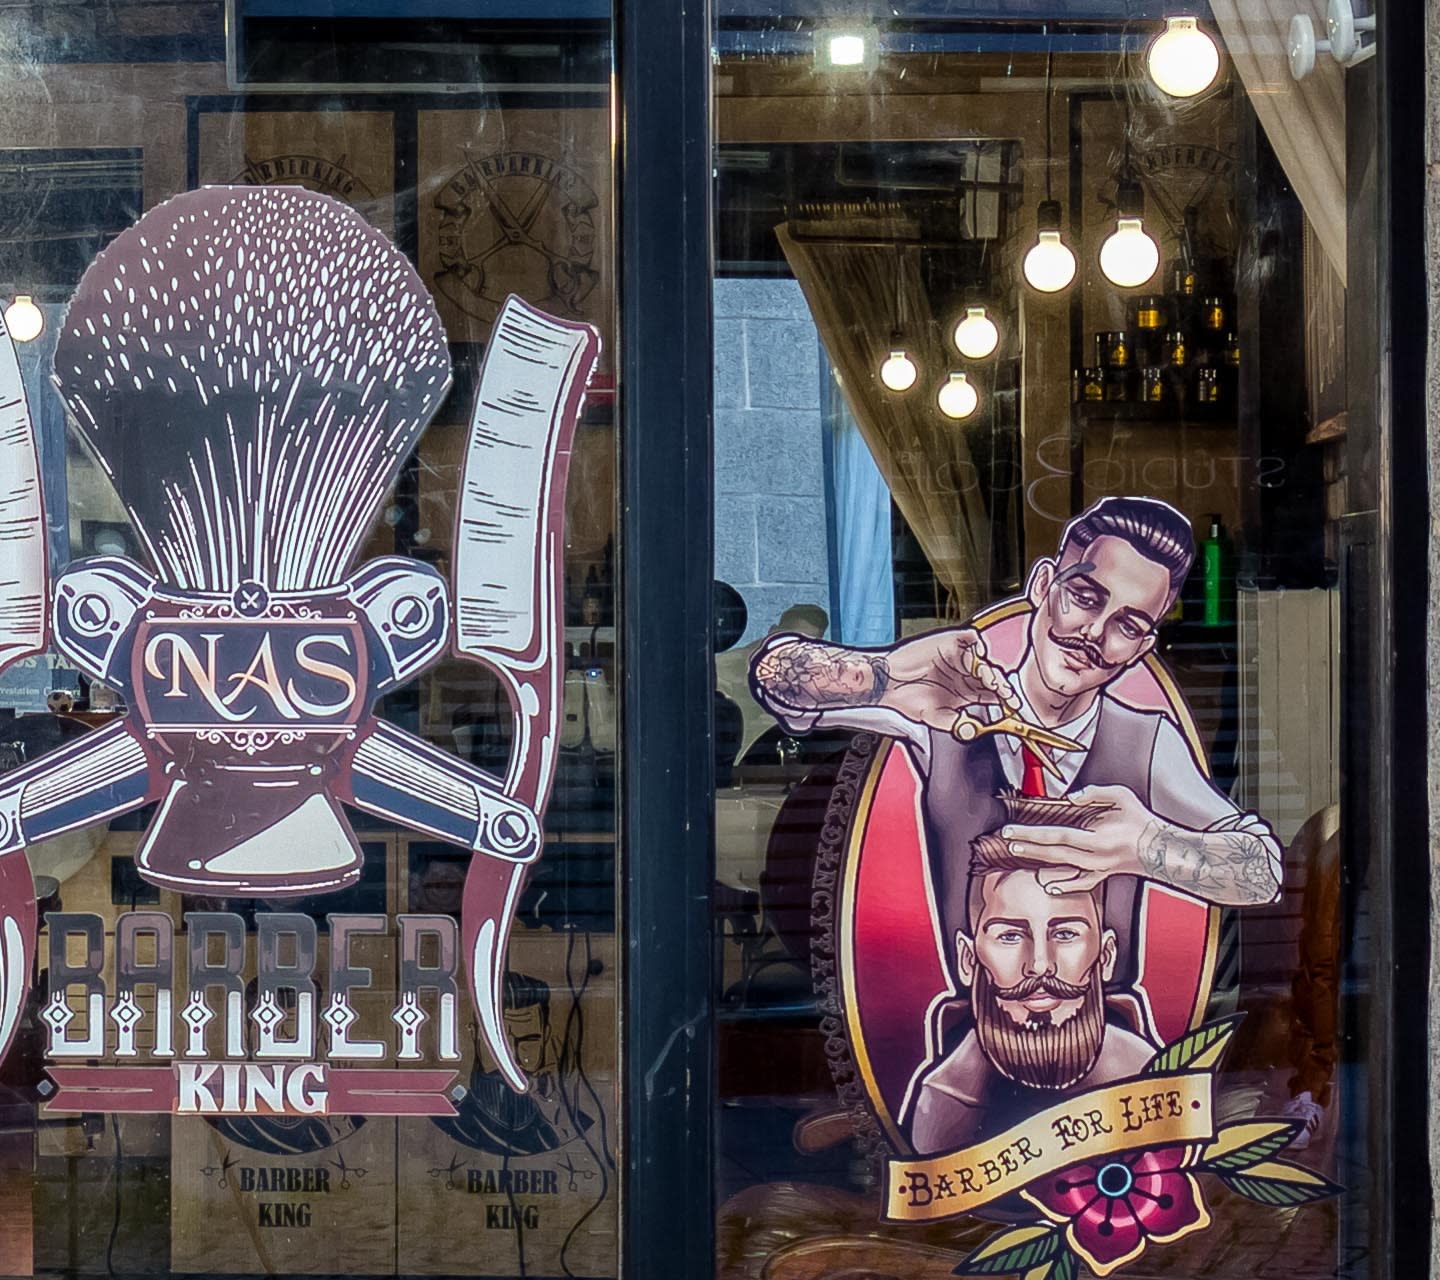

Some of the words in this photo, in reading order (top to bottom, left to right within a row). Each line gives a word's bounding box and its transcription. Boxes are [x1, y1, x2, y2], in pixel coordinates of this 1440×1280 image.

[144, 631, 356, 723] NAS
[41, 912, 462, 1061] BARBER
[177, 1063, 329, 1115] KING
[239, 1167, 331, 1194] BARBER
[467, 1168, 559, 1195] BARBER
[258, 1202, 313, 1228] KING
[486, 1204, 540, 1230] KING
